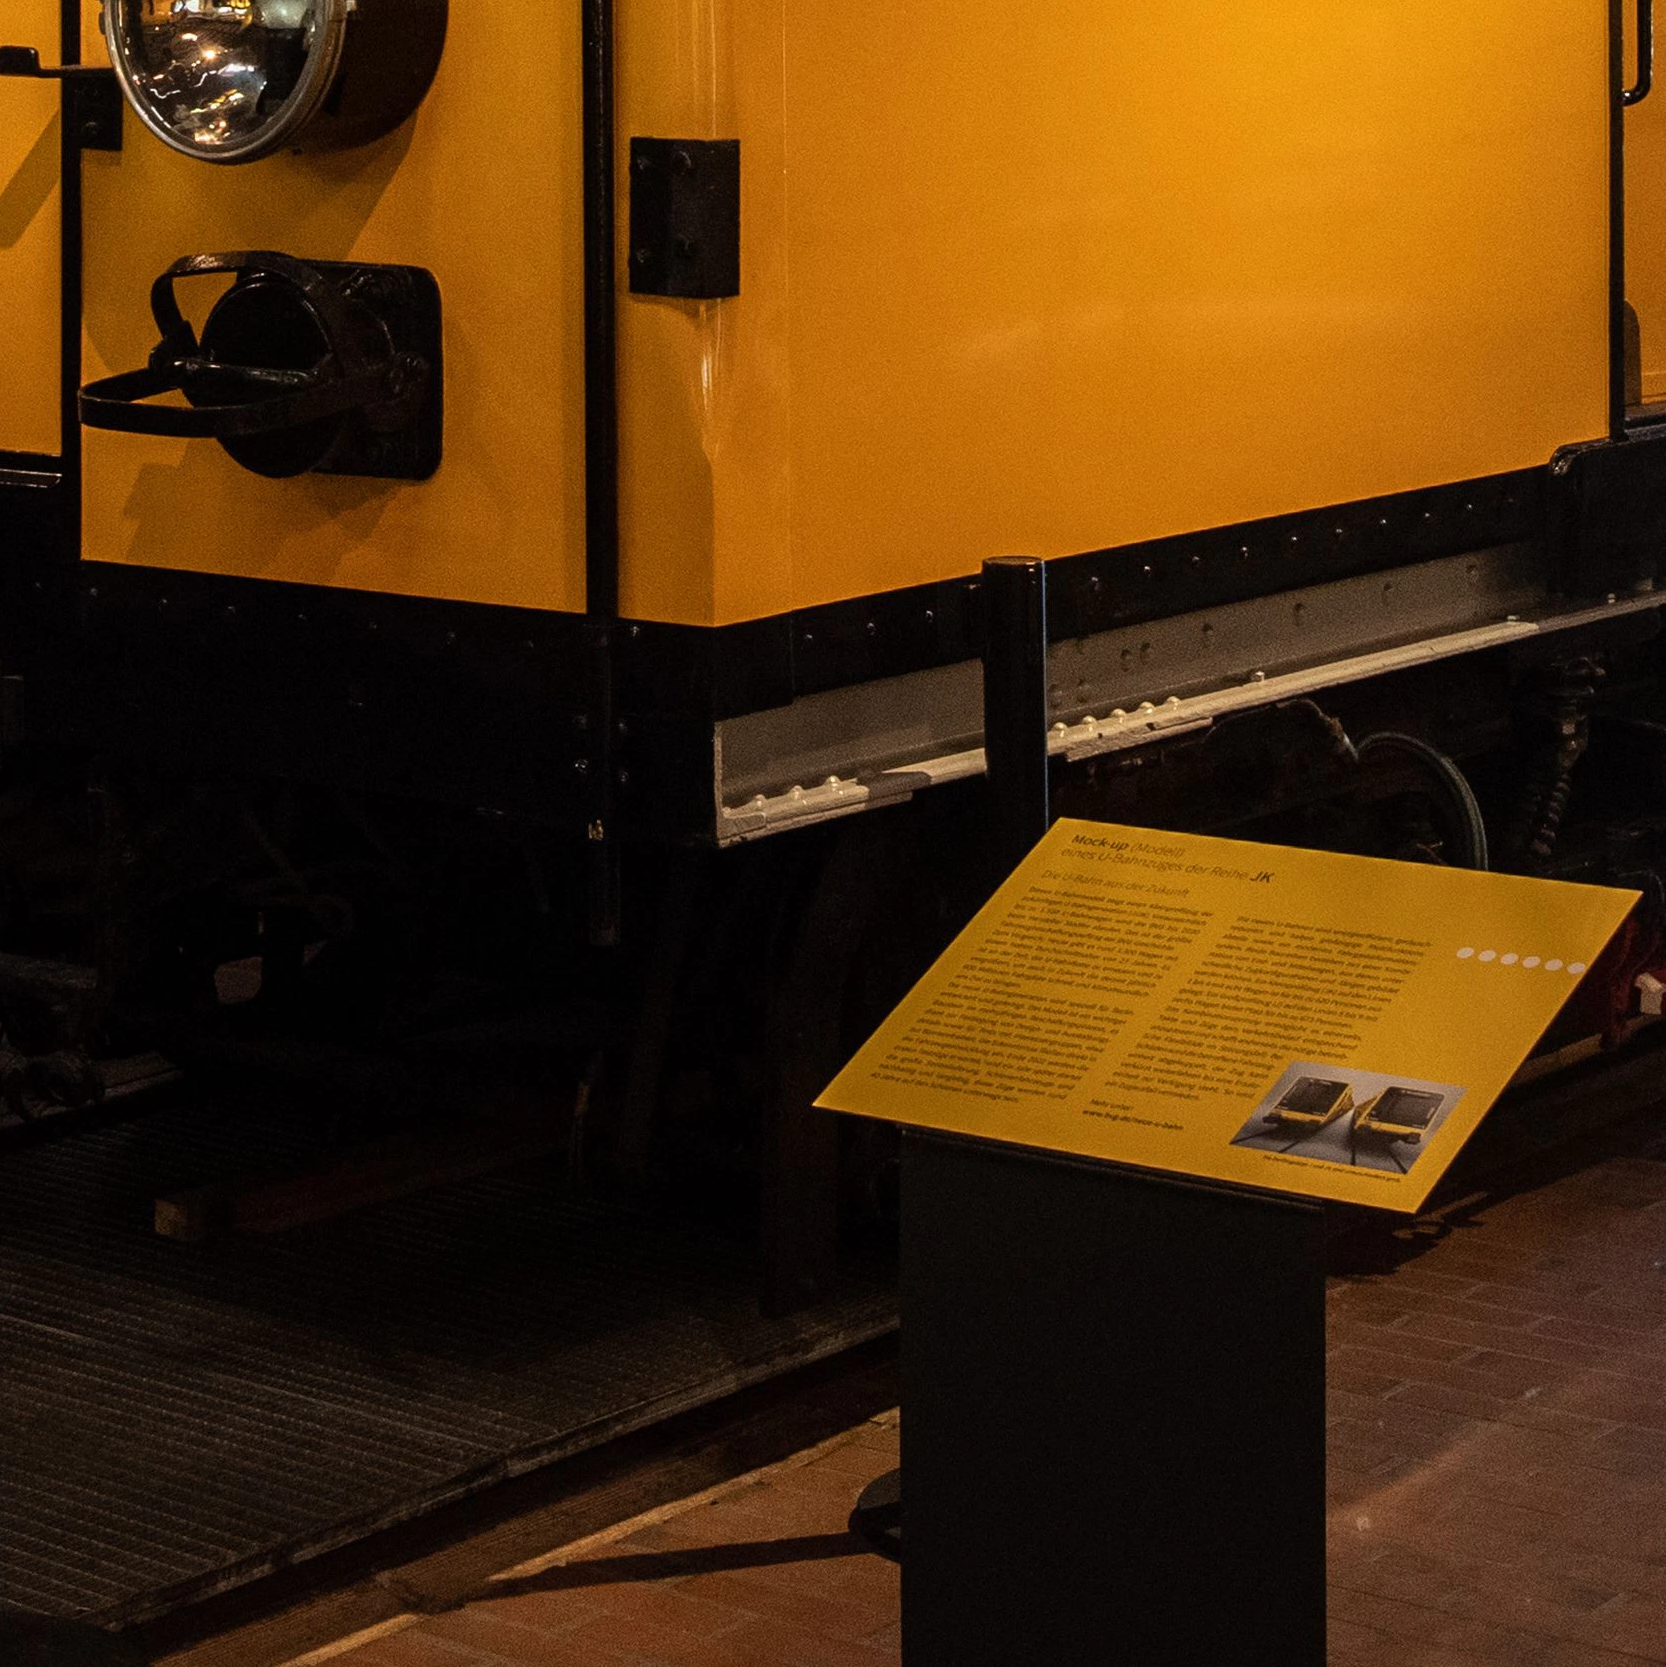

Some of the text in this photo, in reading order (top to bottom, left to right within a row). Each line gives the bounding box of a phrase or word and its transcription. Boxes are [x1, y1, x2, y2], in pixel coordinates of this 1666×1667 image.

[1071, 834, 1185, 857] Mock-up (Modell)
[1061, 849, 1275, 883] eines U-Bahnzuges der Reihe JK
